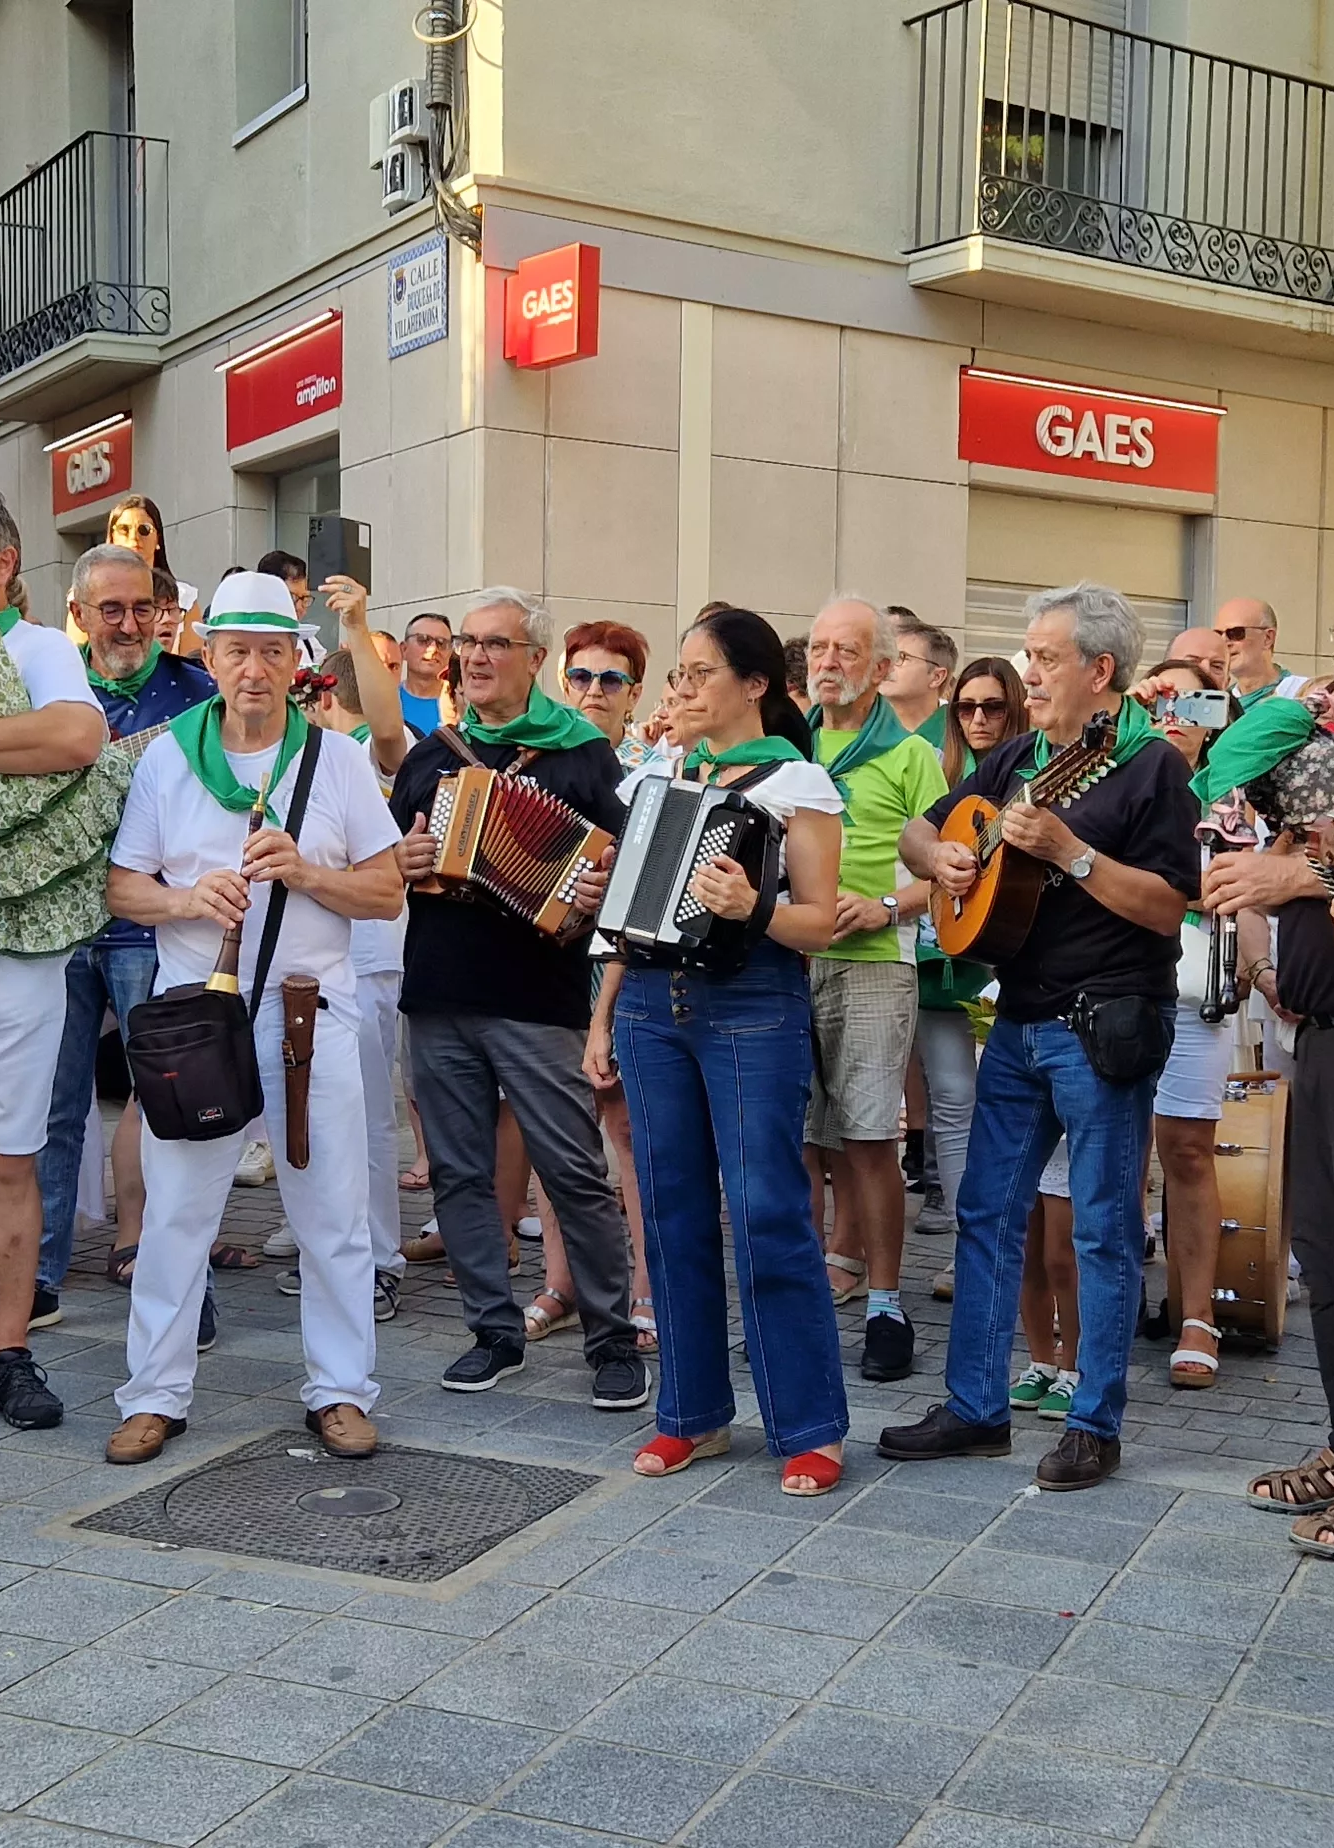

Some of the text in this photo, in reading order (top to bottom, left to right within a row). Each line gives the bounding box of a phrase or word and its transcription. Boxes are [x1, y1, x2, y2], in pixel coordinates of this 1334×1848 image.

[410, 258, 439, 287] CALLE
[407, 280, 441, 313] DUQUESA DE
[523, 279, 573, 319] GAES
[394, 305, 440, 340] VILLAHERMOSA
[296, 375, 337, 406] amplifon
[1036, 404, 1154, 468] GAES
[66, 441, 112, 494] GAES
[633, 785, 658, 845] HOHNER
